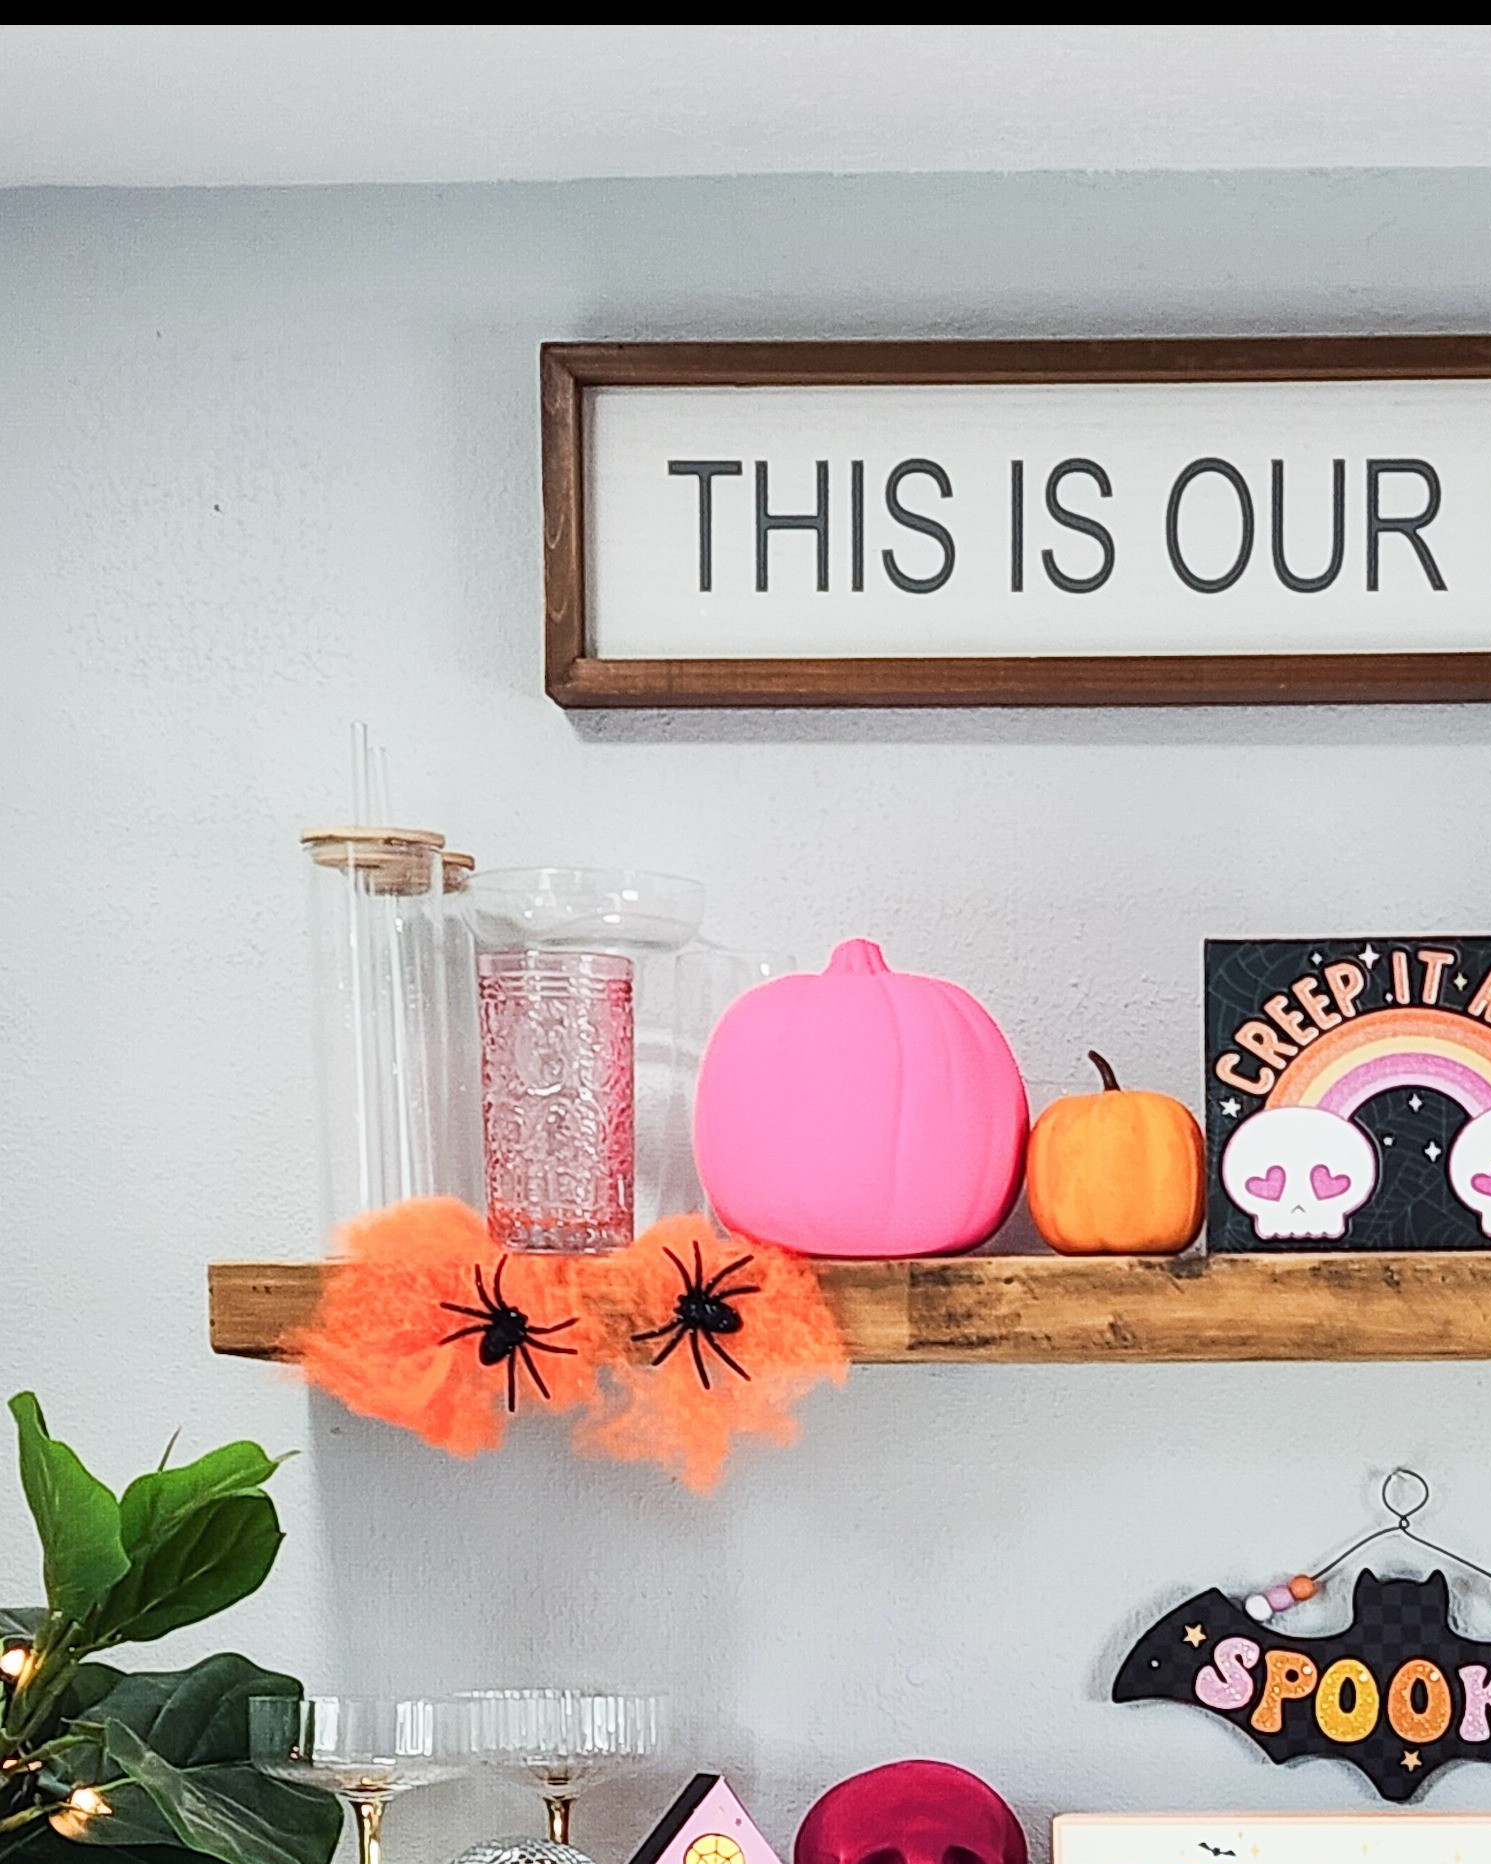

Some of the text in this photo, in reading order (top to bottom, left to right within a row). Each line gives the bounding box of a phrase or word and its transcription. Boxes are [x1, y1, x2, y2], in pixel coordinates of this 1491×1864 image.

[667, 459, 956, 595] THIS
[1011, 457, 1115, 594] IS
[1165, 457, 1448, 594] OUR
[1215, 963, 1367, 1095] CREEP
[1391, 950, 1455, 1005] IT
